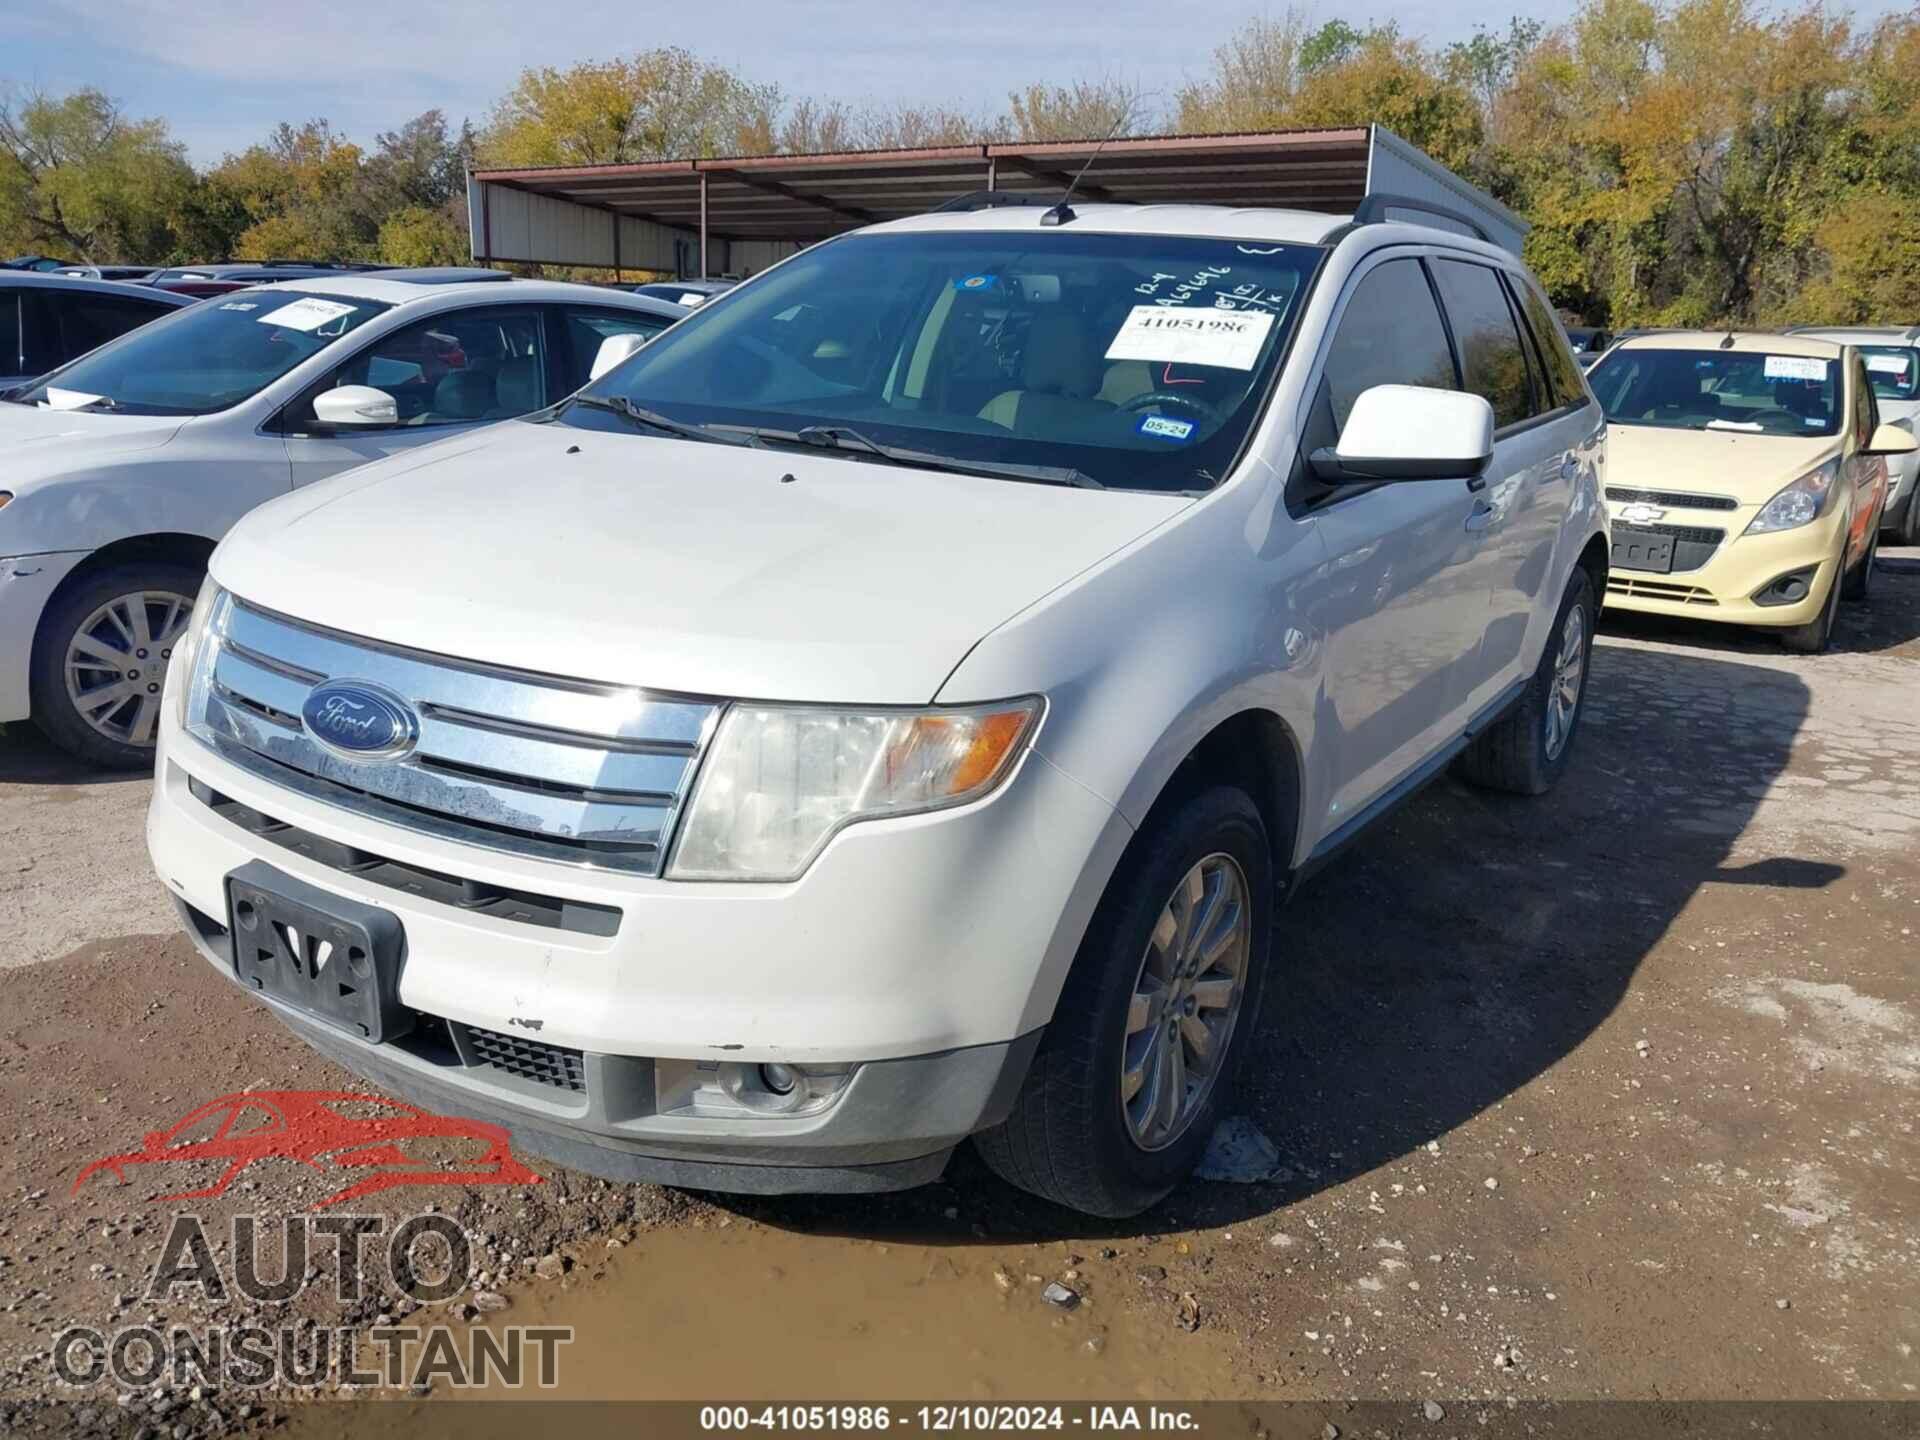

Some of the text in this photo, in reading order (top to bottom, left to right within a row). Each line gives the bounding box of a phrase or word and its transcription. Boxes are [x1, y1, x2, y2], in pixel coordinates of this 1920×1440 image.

[1138, 318, 1250, 333] 41051986
[1146, 420, 1187, 434] 05-24
[317, 695, 377, 738] Ford
